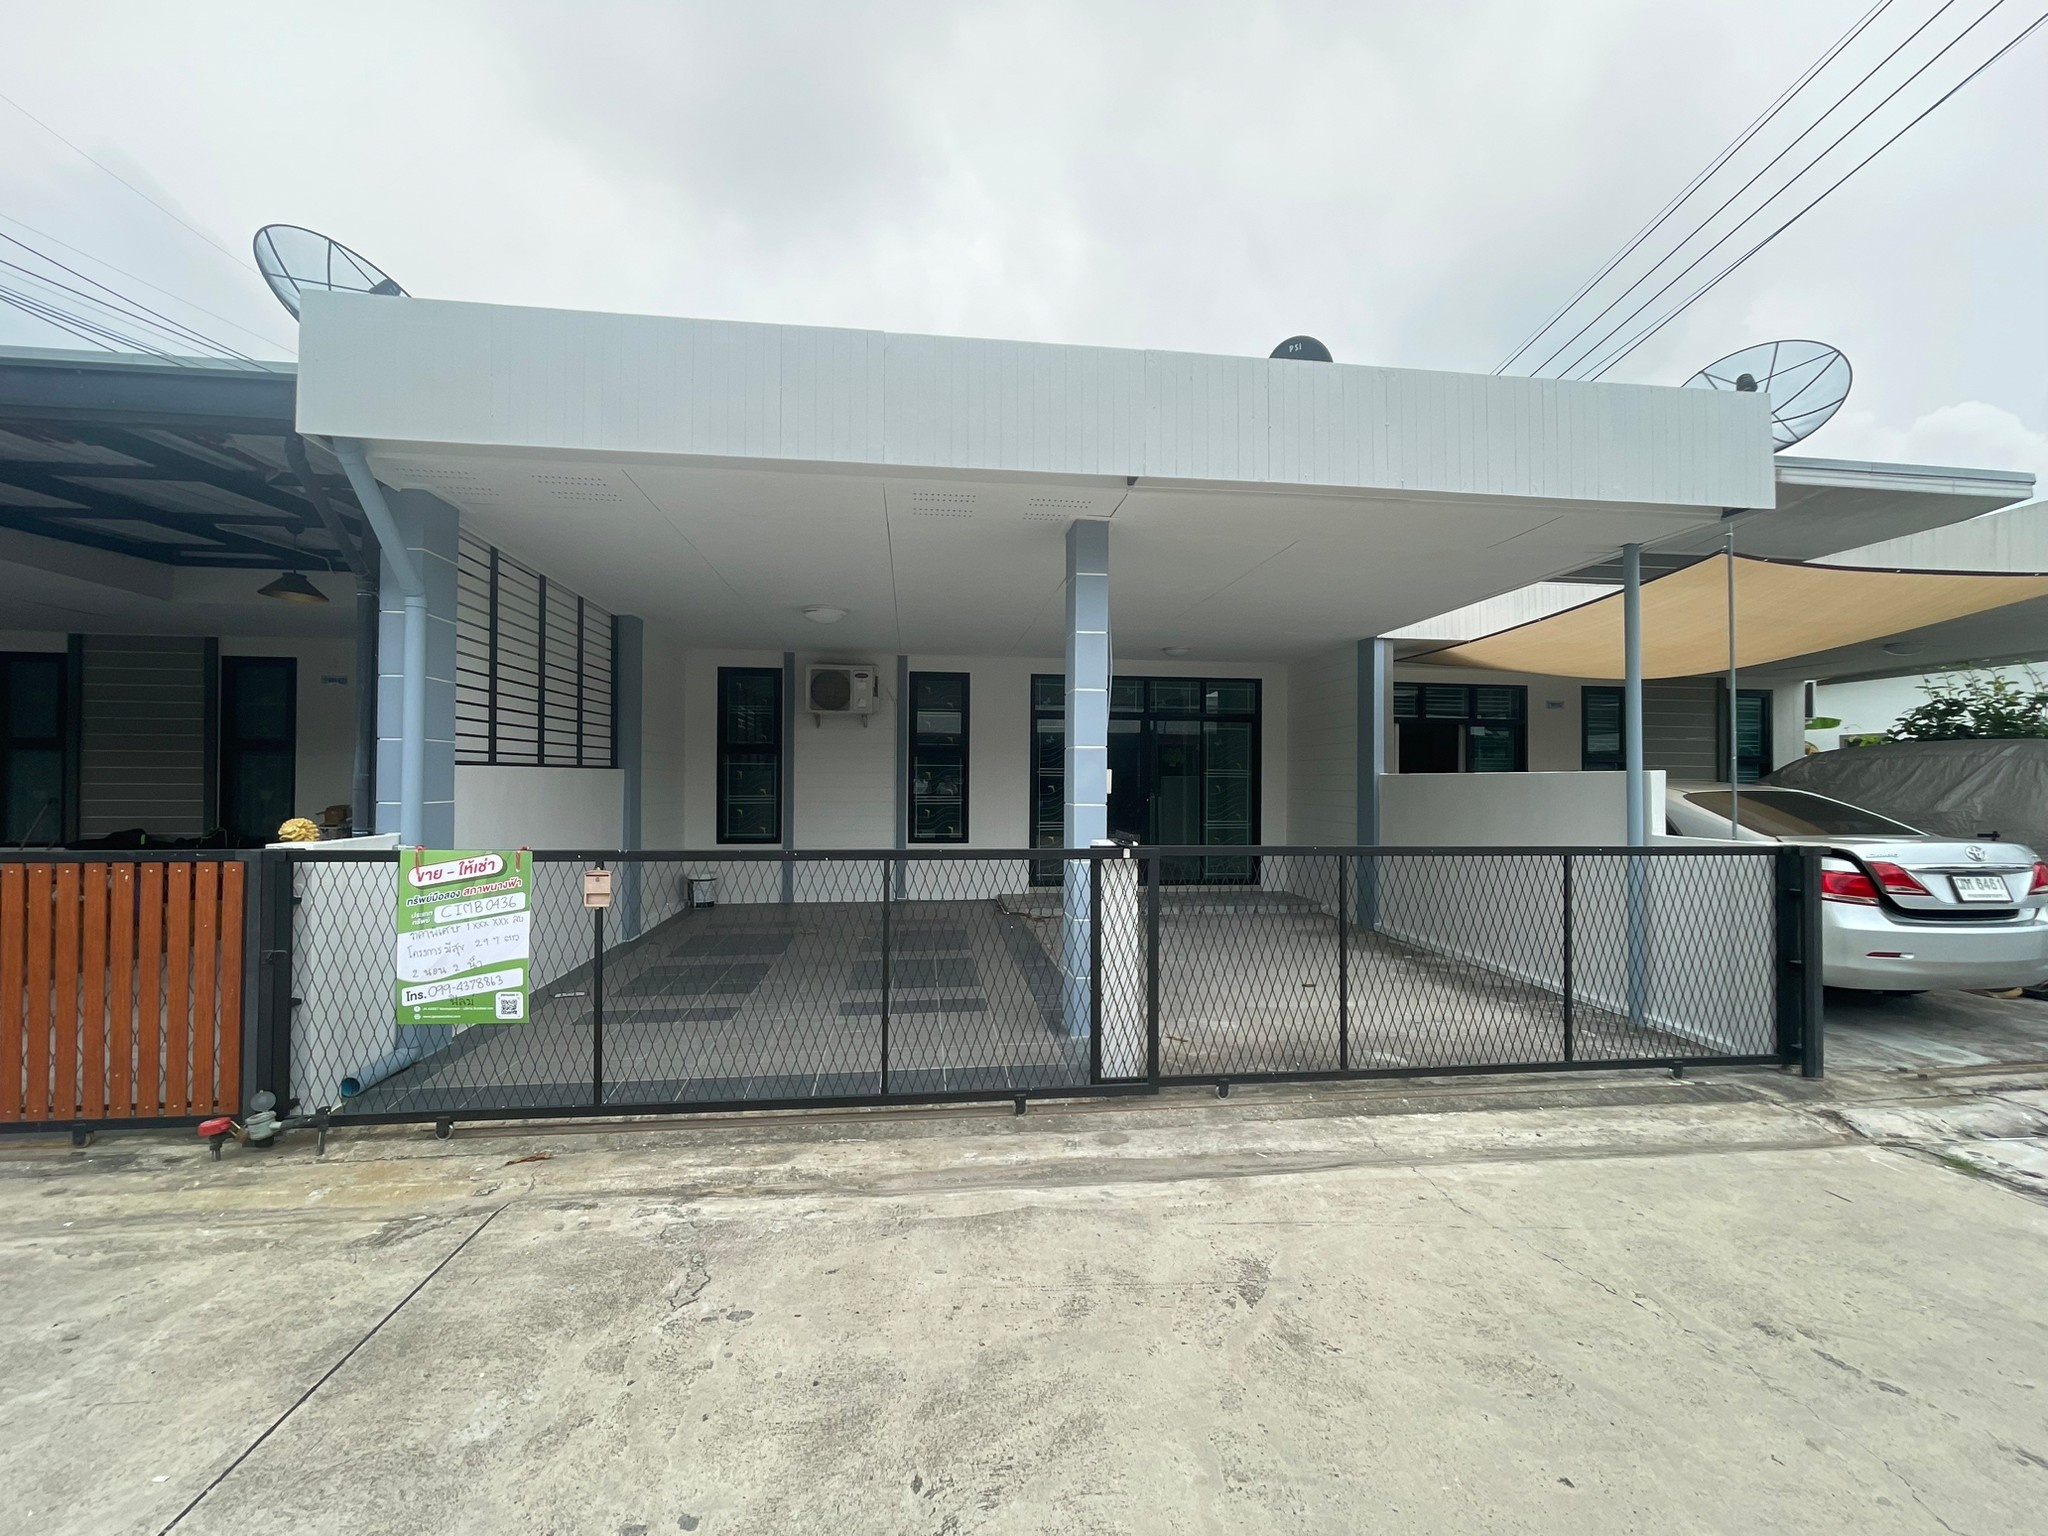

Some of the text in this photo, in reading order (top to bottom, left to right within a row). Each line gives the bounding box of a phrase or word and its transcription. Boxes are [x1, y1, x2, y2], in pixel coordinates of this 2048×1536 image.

[1289, 343, 1302, 353] PSI
[458, 858, 496, 876] ให้เช่า
[406, 877, 523, 906] ทรัพย์มือสอง สภาพนางฟ้า
[428, 975, 504, 998] 099-4378863
